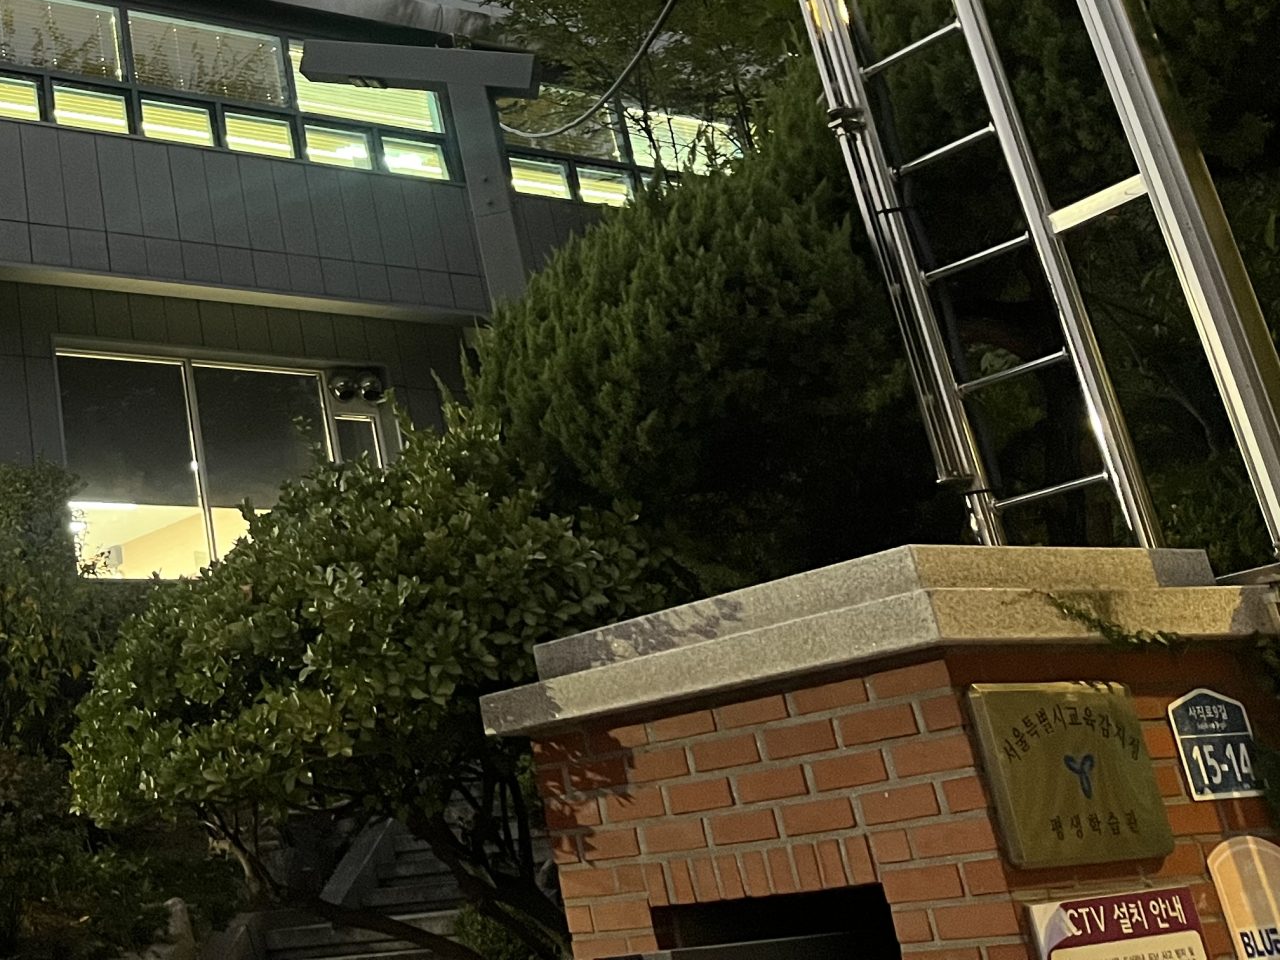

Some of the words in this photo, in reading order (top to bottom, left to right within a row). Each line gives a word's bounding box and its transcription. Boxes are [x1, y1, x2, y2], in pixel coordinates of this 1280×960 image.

[1188, 704, 1228, 720] 사직로9길
[1192, 743, 1256, 785] 15-14
[1049, 809, 1140, 841] 평생학습관
[1113, 900, 1149, 934] 설치
[1149, 894, 1187, 929] 안내
